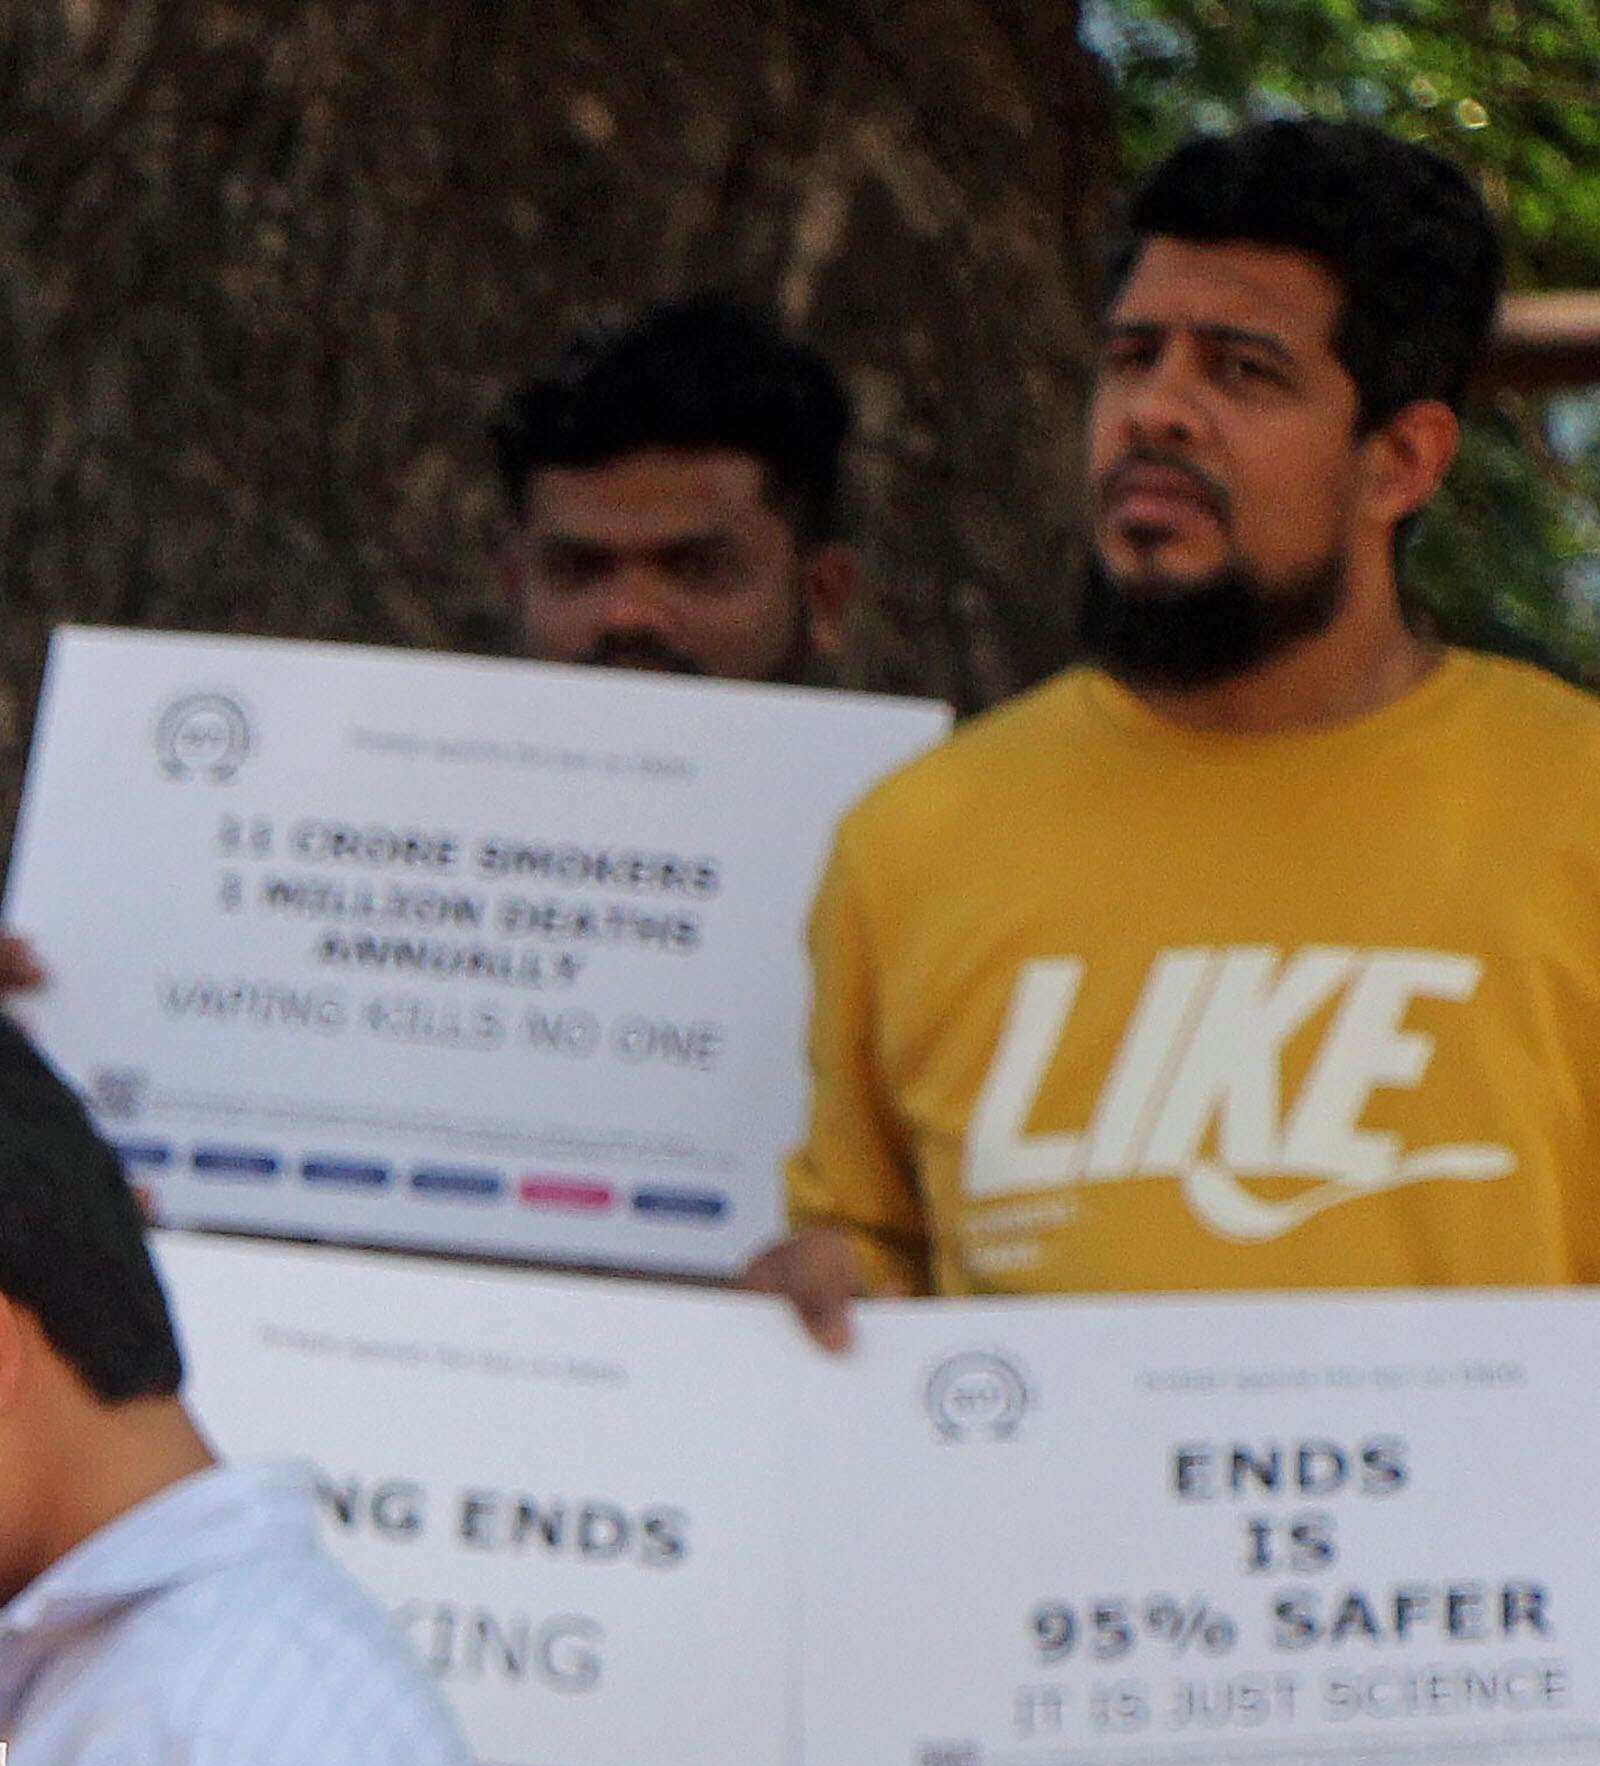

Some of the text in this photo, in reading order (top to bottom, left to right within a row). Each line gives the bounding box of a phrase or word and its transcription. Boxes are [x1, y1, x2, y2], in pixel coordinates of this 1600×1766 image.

[963, 947, 1482, 1195] LIKE
[1171, 1441, 1408, 1499] ENDS
[459, 1493, 687, 1564] ENDS
[1247, 1517, 1335, 1572] IS
[1028, 1578, 1551, 1664] 95% SAFER
[1171, 1673, 1299, 1728] JUST
[1324, 1661, 1567, 1720] SCIENCE
